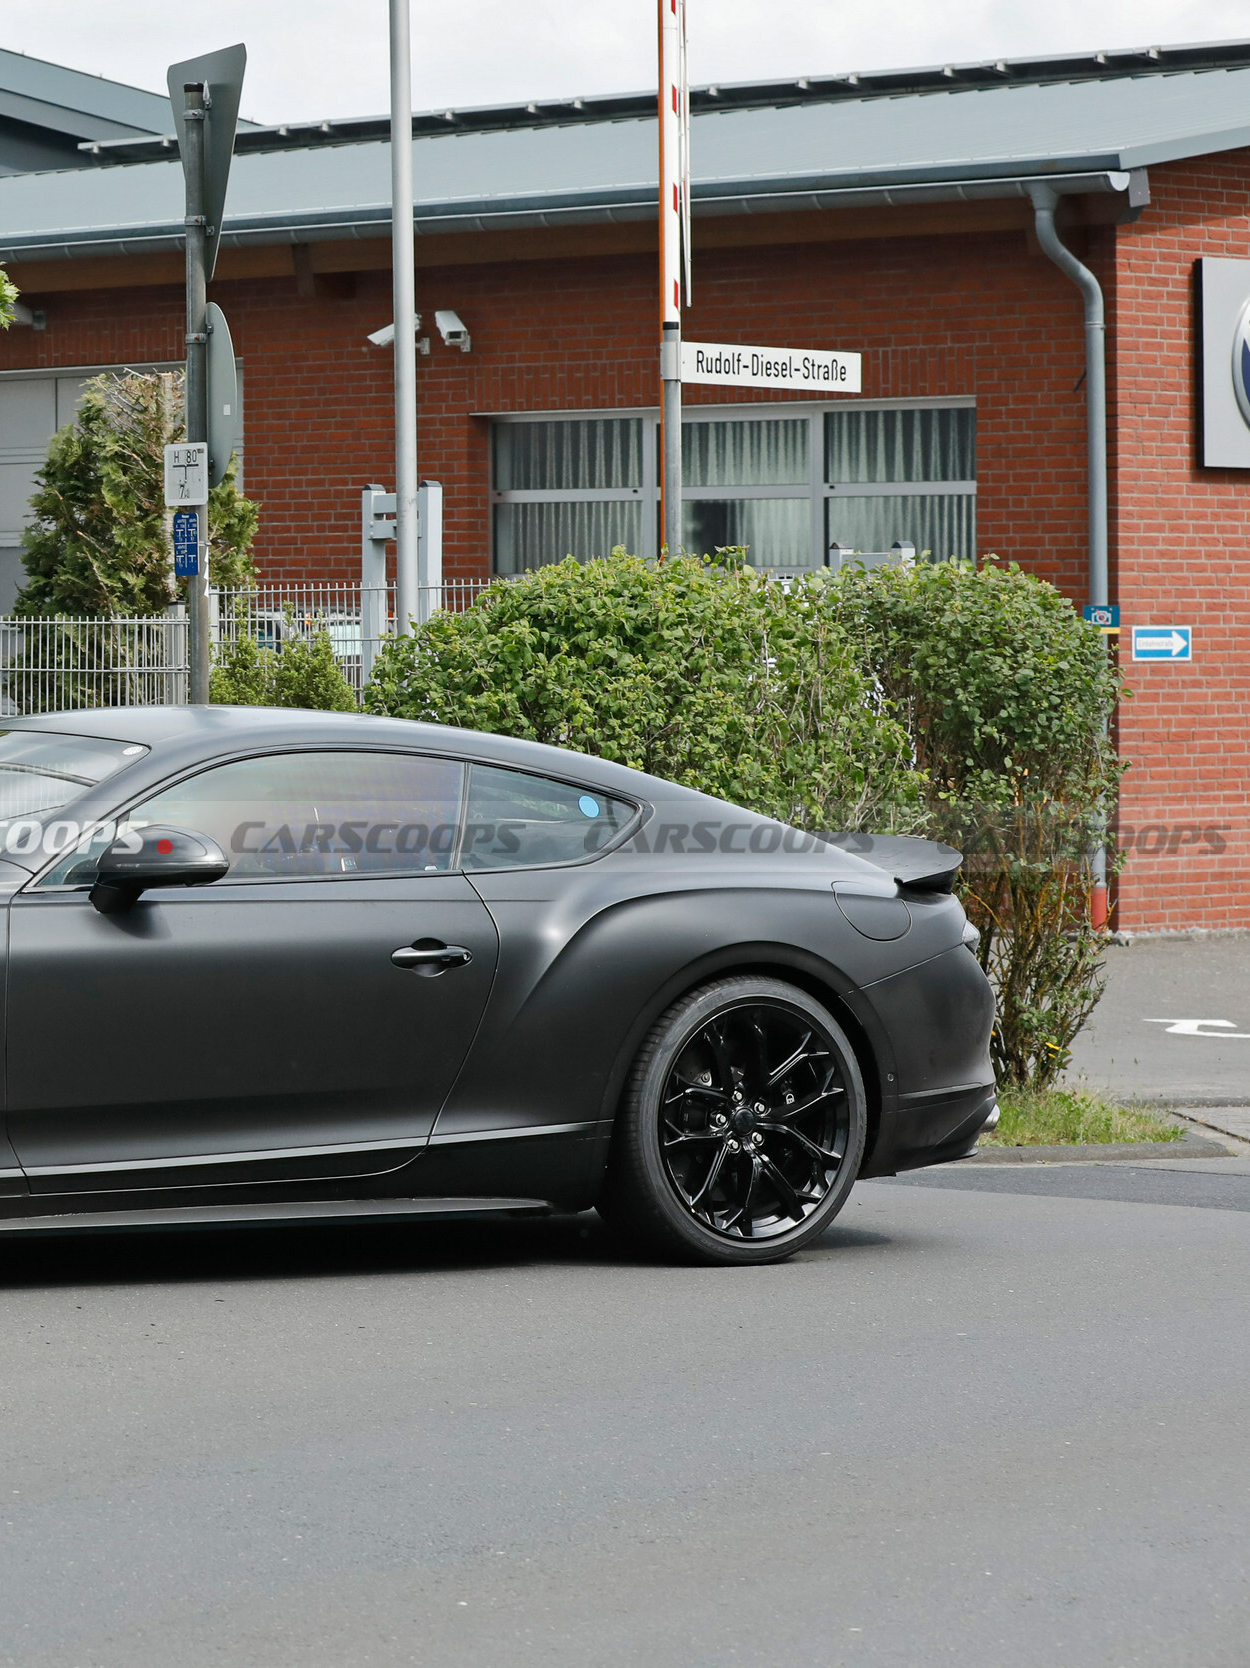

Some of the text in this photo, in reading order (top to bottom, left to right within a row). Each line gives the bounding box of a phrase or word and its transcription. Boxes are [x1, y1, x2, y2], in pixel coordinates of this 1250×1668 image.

[696, 350, 847, 381] Rudolf-Diesel-Straße
[174, 449, 197, 463] H 80
